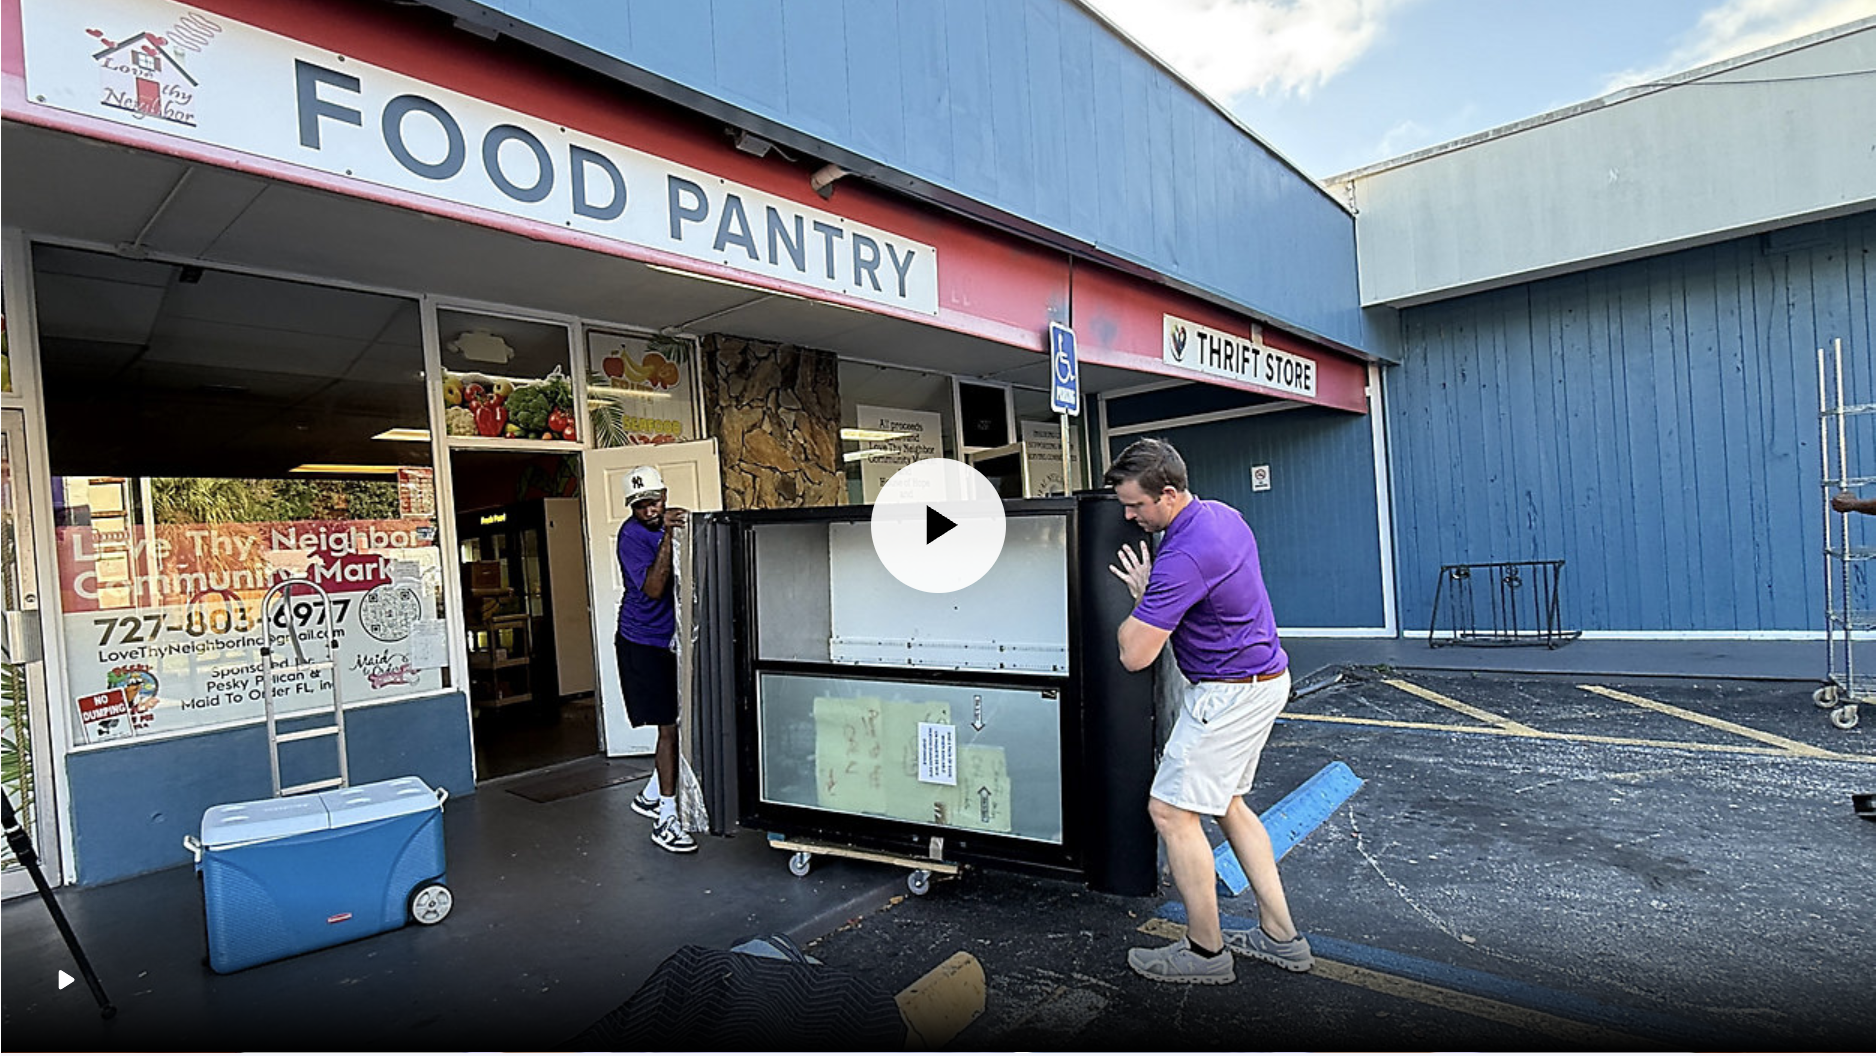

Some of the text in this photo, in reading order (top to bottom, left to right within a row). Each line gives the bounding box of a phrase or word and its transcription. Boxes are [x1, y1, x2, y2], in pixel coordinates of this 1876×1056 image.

[161, 84, 193, 105] thy
[294, 58, 917, 300] FOOD PANTRY
[1196, 331, 1312, 391] THRIFT STORE
[622, 414, 682, 435] SEAFOOD
[73, 534, 172, 561] Lve
[186, 530, 256, 561] Thy
[94, 599, 351, 646] 727-803-6977
[211, 658, 289, 679] Sponsoed
[207, 669, 322, 693] Pesky Plican &
[93, 694, 109, 706] NO
[181, 693, 220, 711] Maid
[225, 693, 244, 706] To
[83, 703, 126, 721] DUMPING
